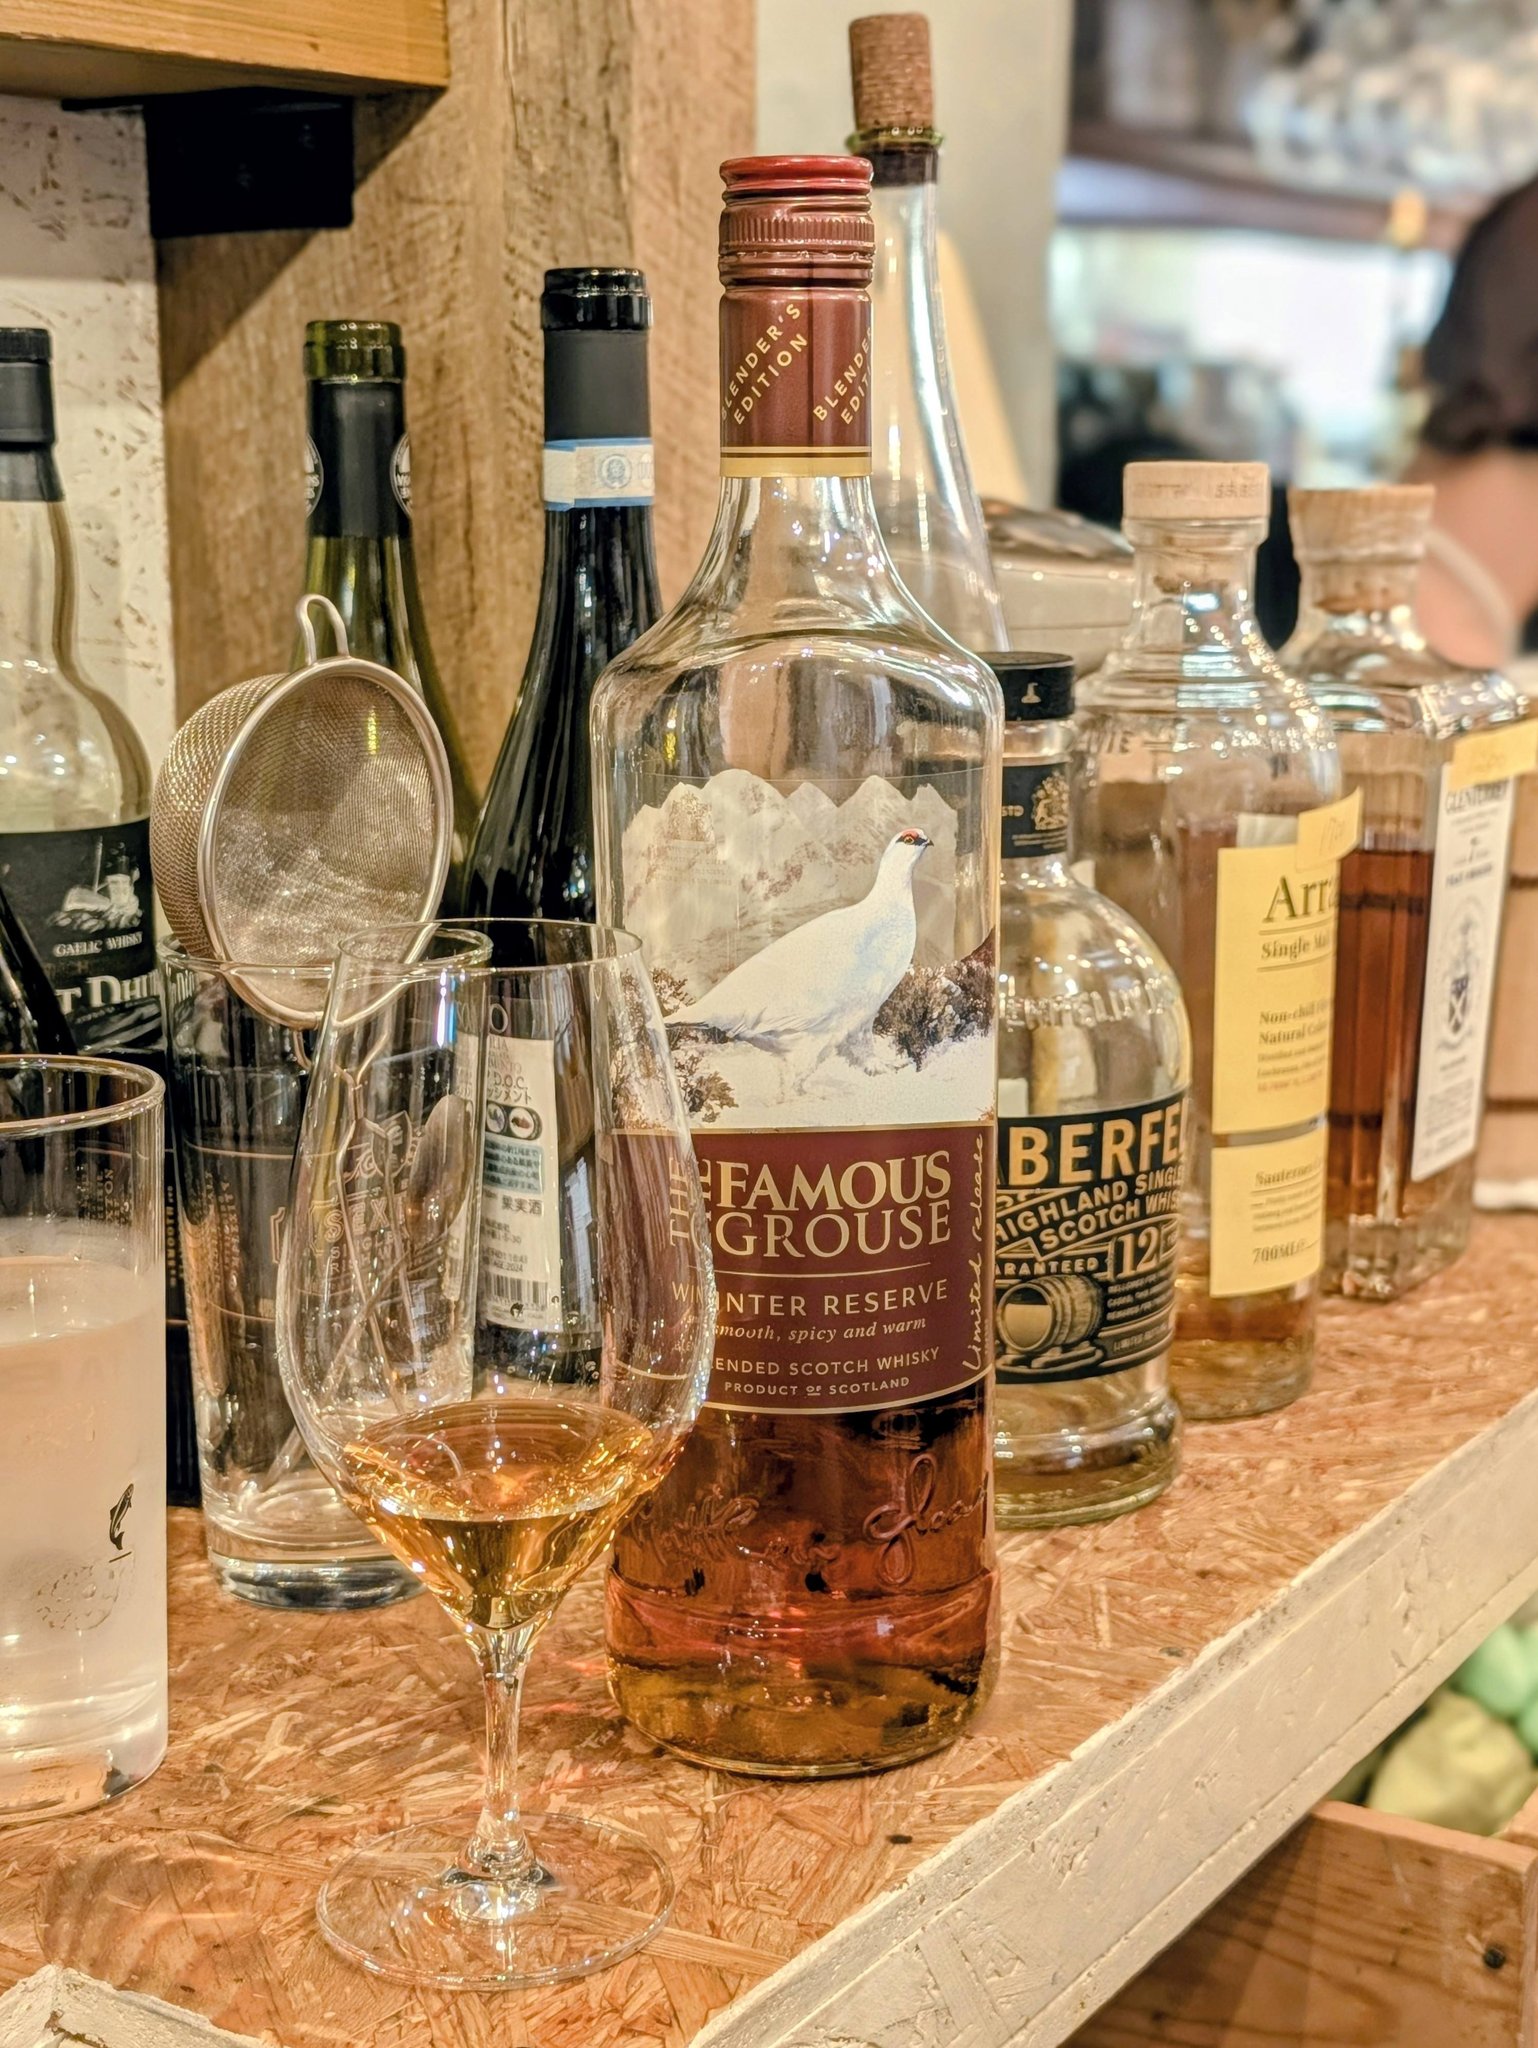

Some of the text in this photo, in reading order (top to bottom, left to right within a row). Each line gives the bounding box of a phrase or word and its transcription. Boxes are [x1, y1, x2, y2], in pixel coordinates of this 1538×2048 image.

[733, 333, 808, 425] EDITION
[1261, 936, 1310, 961] Single
[997, 1096, 1188, 1188] BERFE
[716, 1150, 951, 1212] FAMOUS
[715, 1199, 951, 1259] GROUSE
[1039, 1200, 1140, 1250] SCOTCH
[962, 1133, 984, 1371] Limited release
[1118, 1226, 1161, 1278] 12
[824, 1278, 948, 1316] RESERVE
[788, 1326, 837, 1343] spicy
[843, 1321, 878, 1339] and
[882, 1317, 926, 1335] warm
[724, 1376, 910, 1396] PRODUCT OF SCOTLAND
[789, 1360, 868, 1376] SCOTCH
[876, 1345, 940, 1371] WHISKY
